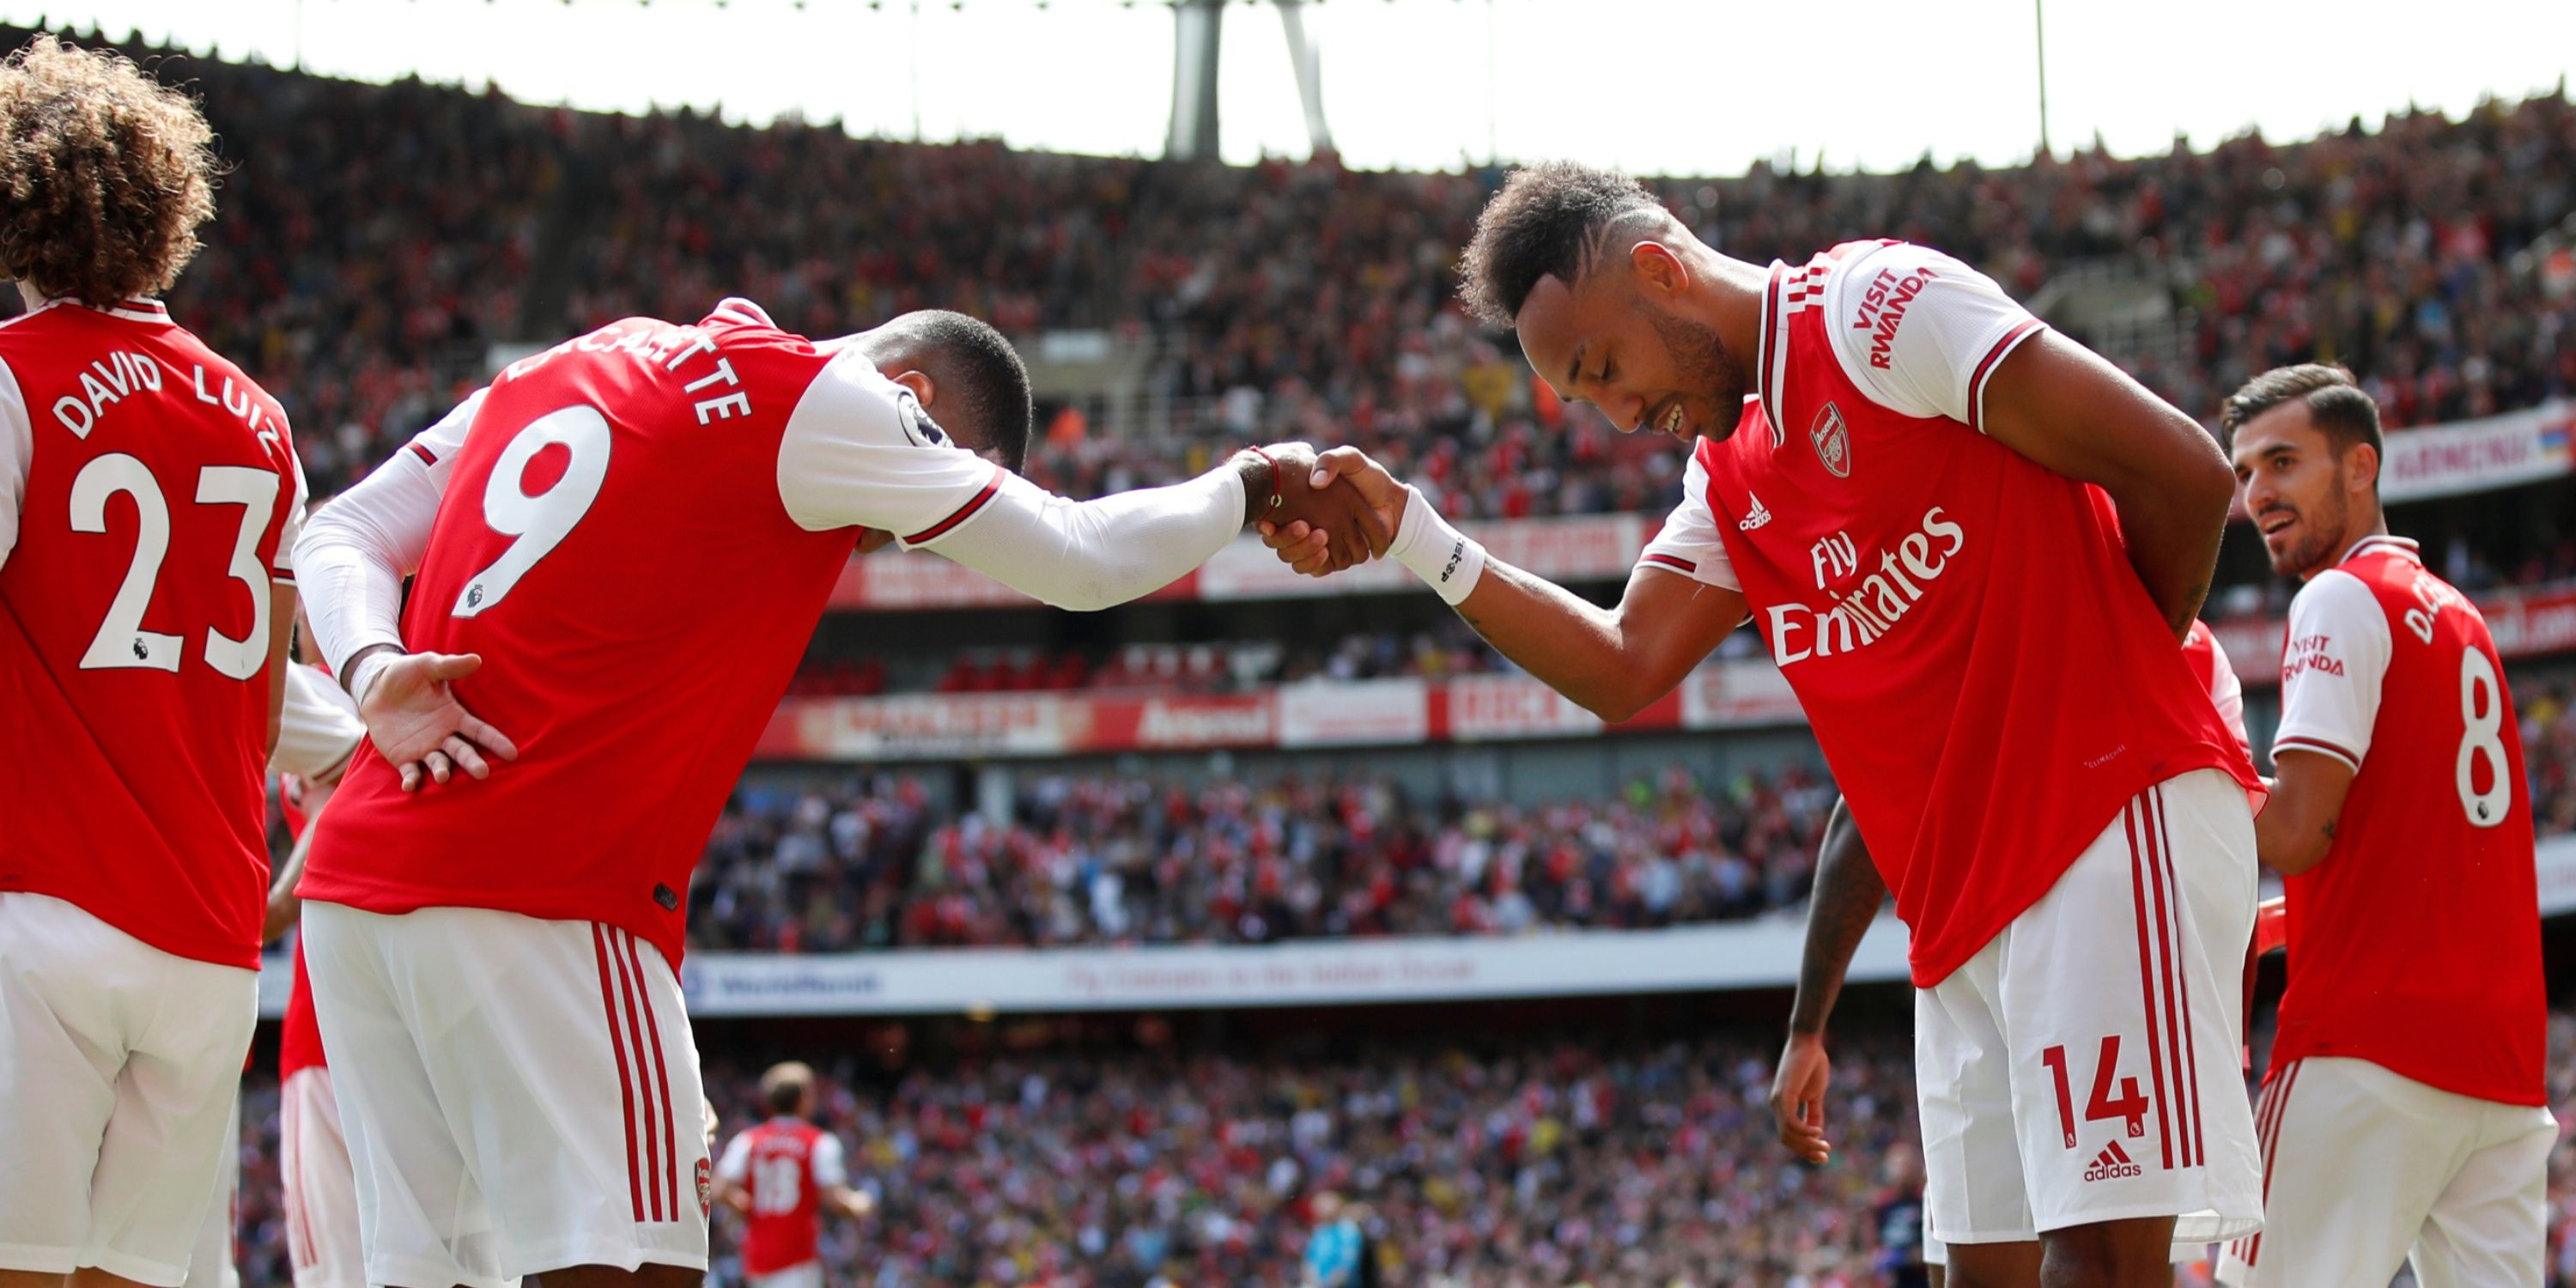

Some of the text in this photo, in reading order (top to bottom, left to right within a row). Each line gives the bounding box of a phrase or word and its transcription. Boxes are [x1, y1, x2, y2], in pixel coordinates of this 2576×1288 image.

[1853, 267, 1898, 329] VISIT
[1870, 267, 1940, 370] RWANDA
[52, 350, 280, 457] DAVID LUIZ
[1815, 410, 1838, 444] Arsenal
[451, 404, 612, 618] 9
[1810, 530, 1857, 591] Fly
[69, 452, 281, 681] 23
[1765, 506, 1965, 668] Emirates
[2456, 645, 2512, 829] 8
[2043, 1035, 2149, 1150] 14
[2084, 1163, 2142, 1182] adidas
